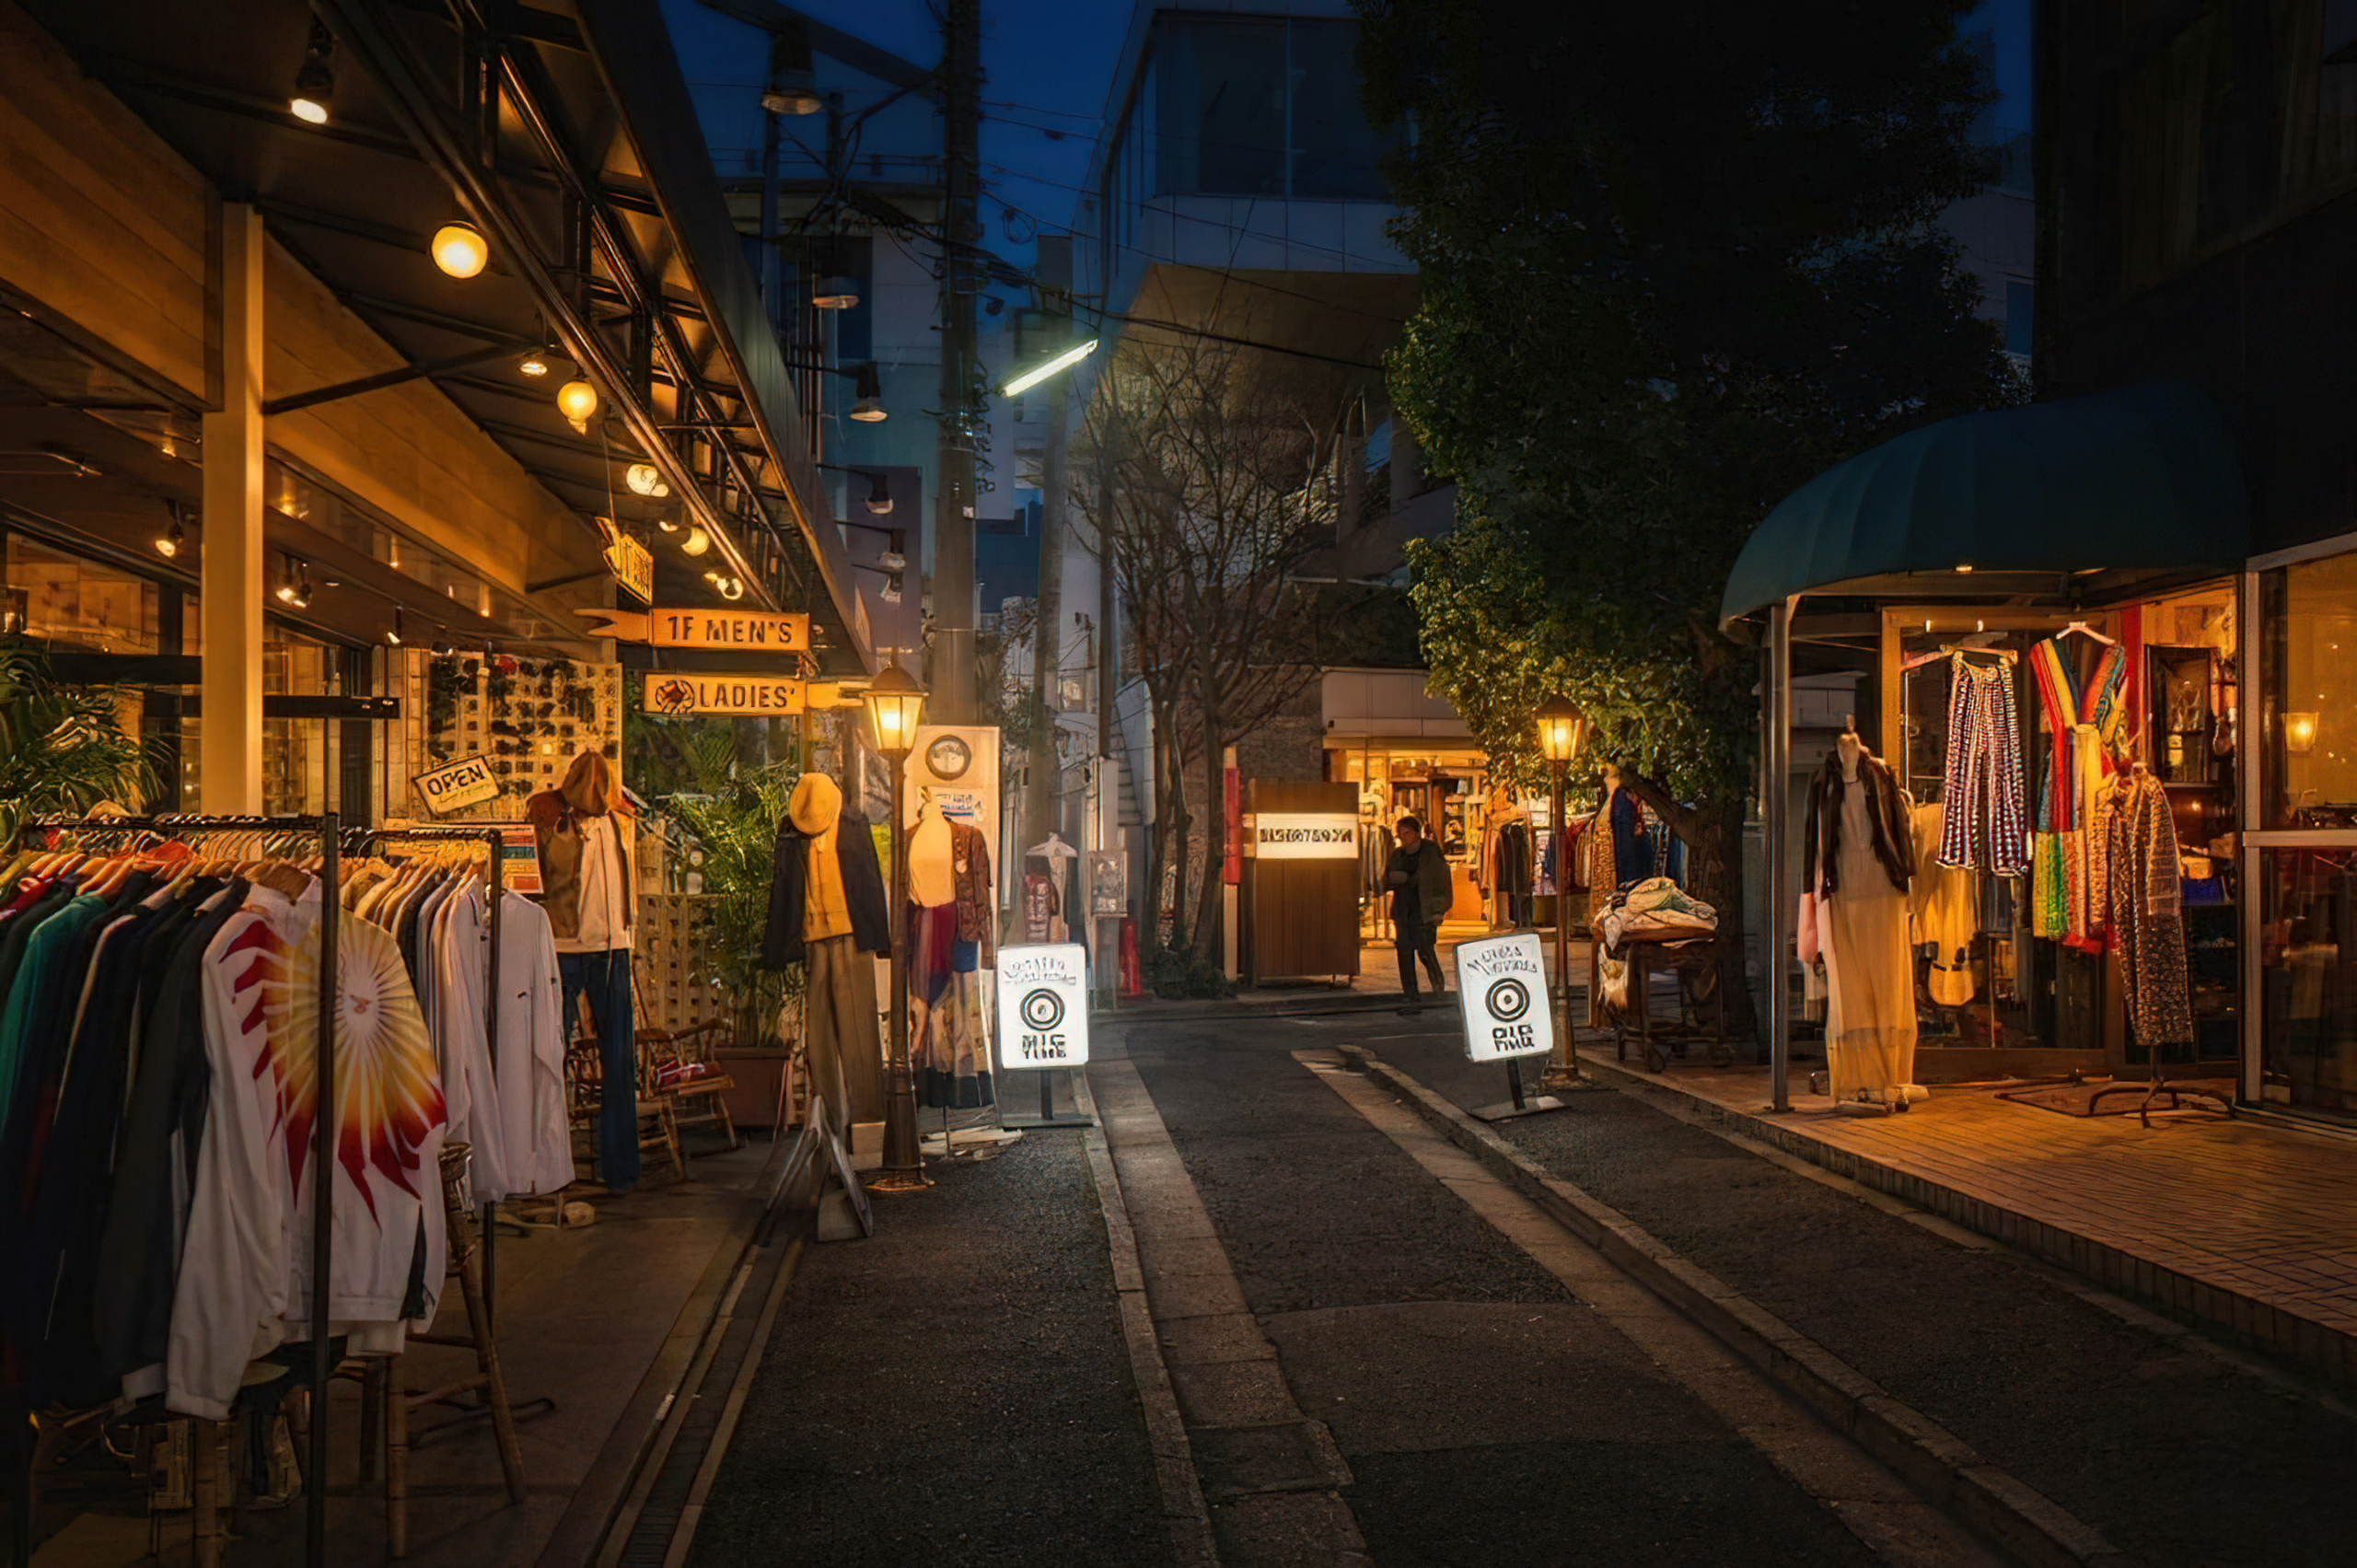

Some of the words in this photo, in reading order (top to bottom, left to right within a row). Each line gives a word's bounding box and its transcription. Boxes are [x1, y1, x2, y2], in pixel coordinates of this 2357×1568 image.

[668, 616, 694, 641] 1F
[705, 618, 793, 644] MEN'S
[426, 763, 486, 796] OPEN
